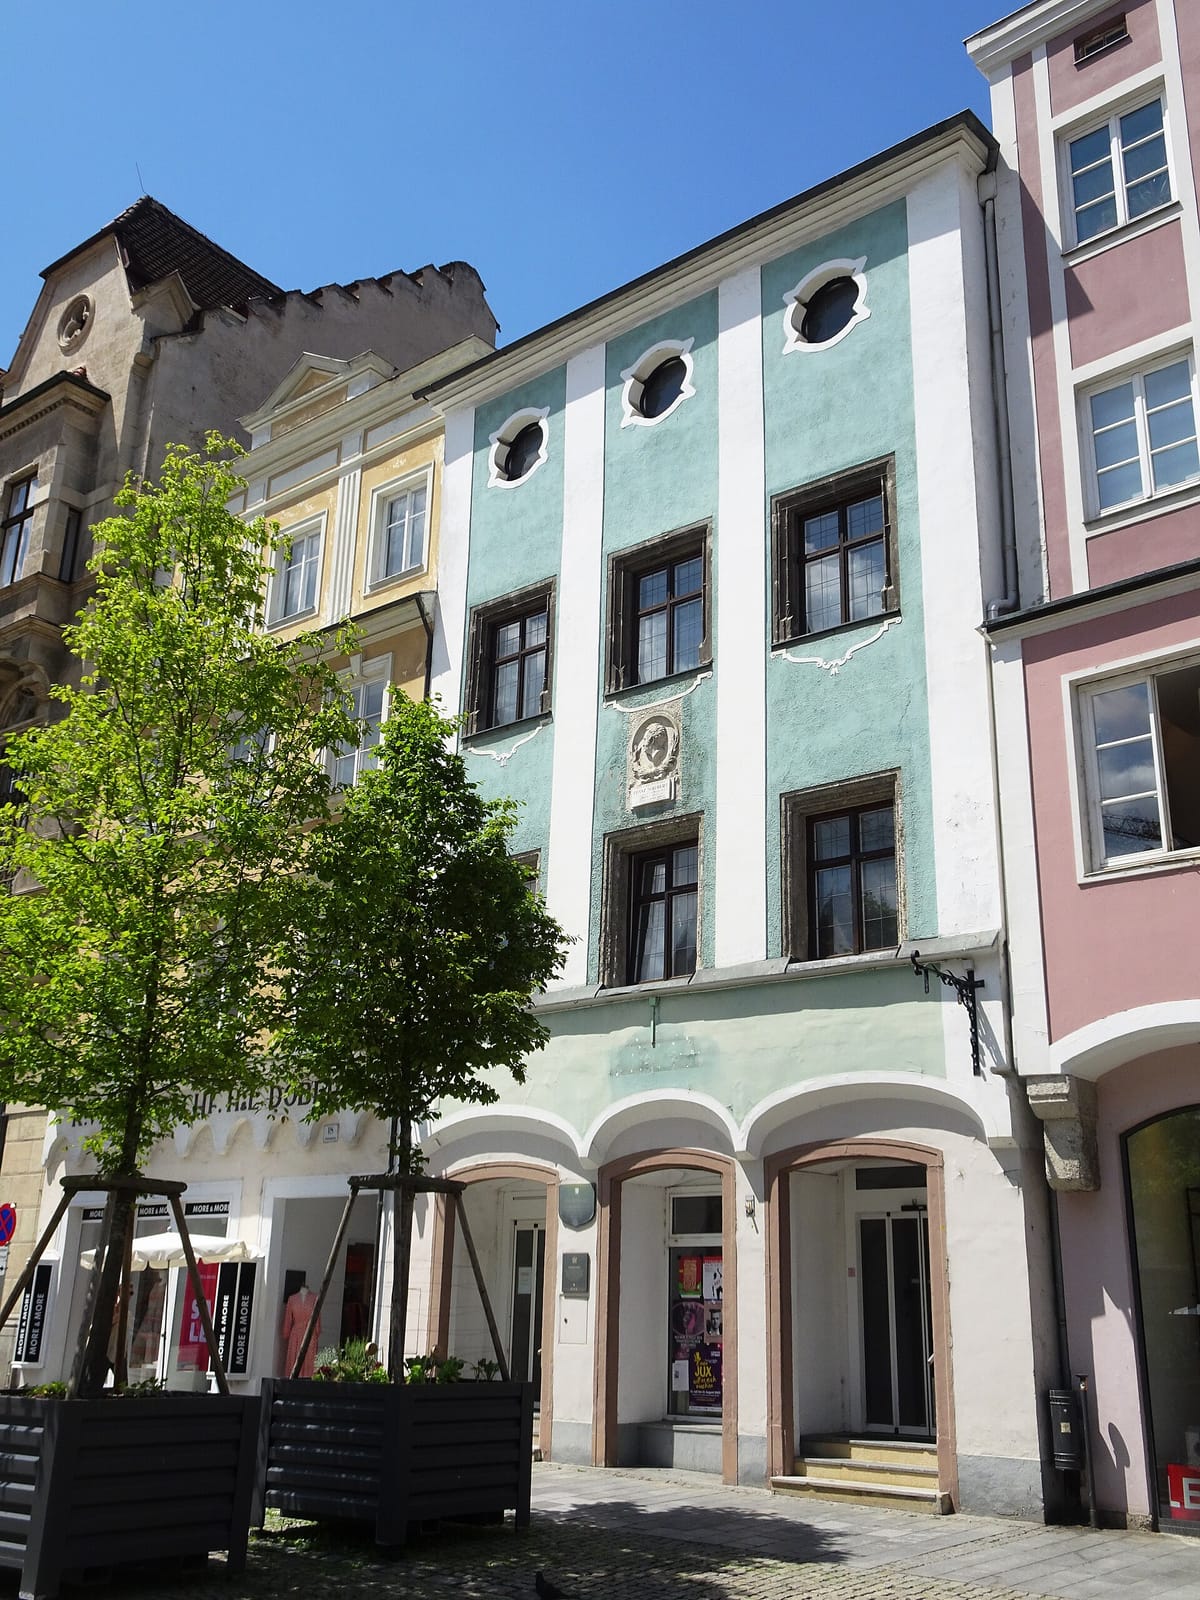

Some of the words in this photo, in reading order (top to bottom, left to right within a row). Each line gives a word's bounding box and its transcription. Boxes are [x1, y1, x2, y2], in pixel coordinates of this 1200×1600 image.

[139, 1206, 155, 1216] MORE
[159, 1205, 168, 1214] MO
[192, 1204, 209, 1213] MORE
[34, 1293, 45, 1320] MORE
[221, 1294, 230, 1325] MORE
[239, 1295, 250, 1325] MORE
[17, 1328, 26, 1355] MORE
[22, 1293, 31, 1320] MORE
[28, 1327, 41, 1356] MORE
[235, 1334, 247, 1365] MORE
